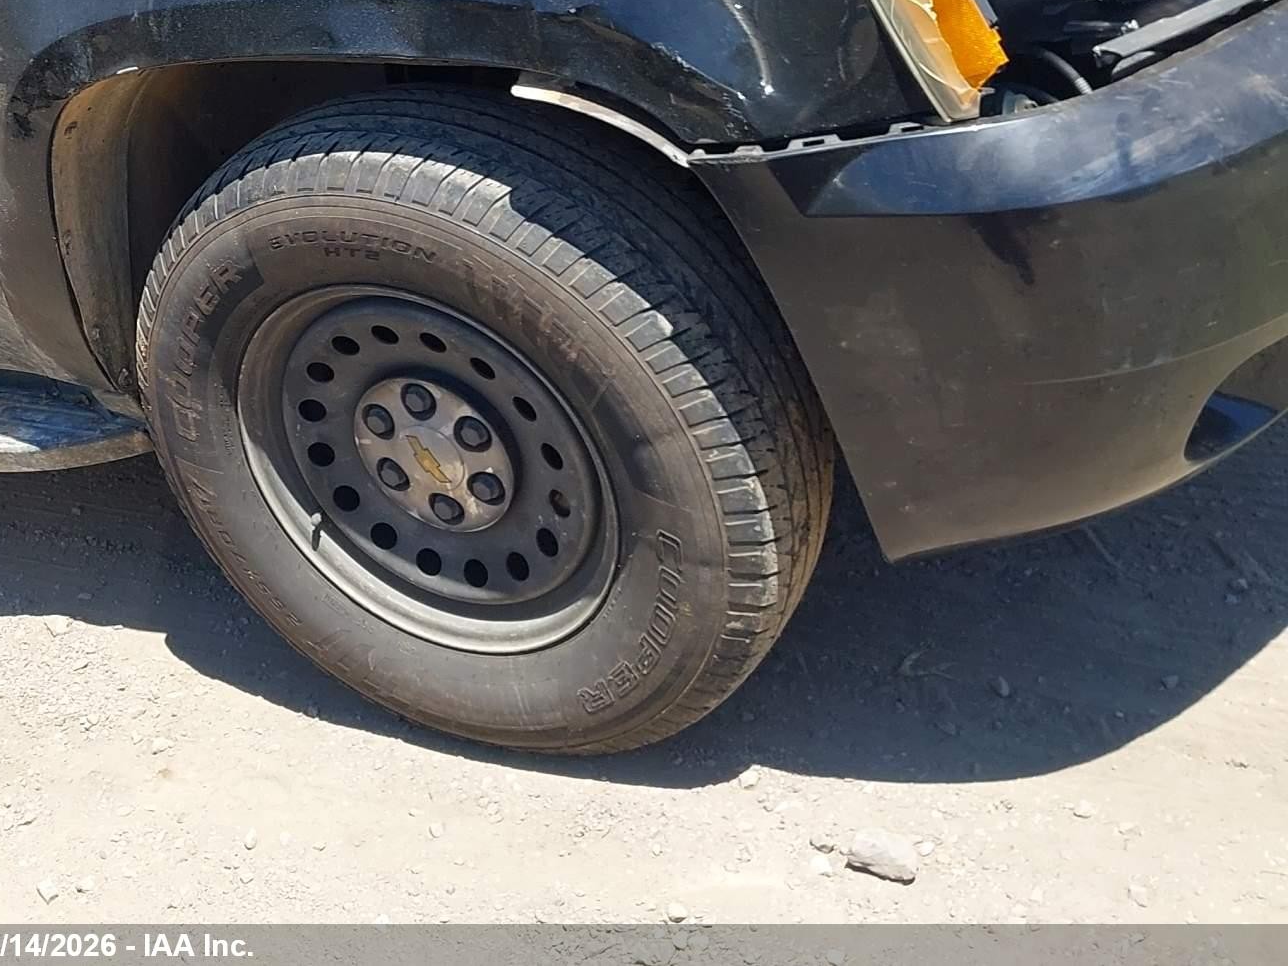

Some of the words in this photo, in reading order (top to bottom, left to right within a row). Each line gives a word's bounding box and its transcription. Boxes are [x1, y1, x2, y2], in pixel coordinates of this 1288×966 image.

[267, 230, 437, 263] EVOLUTION
[324, 247, 381, 261] HT2
[576, 528, 684, 714] COOPER
